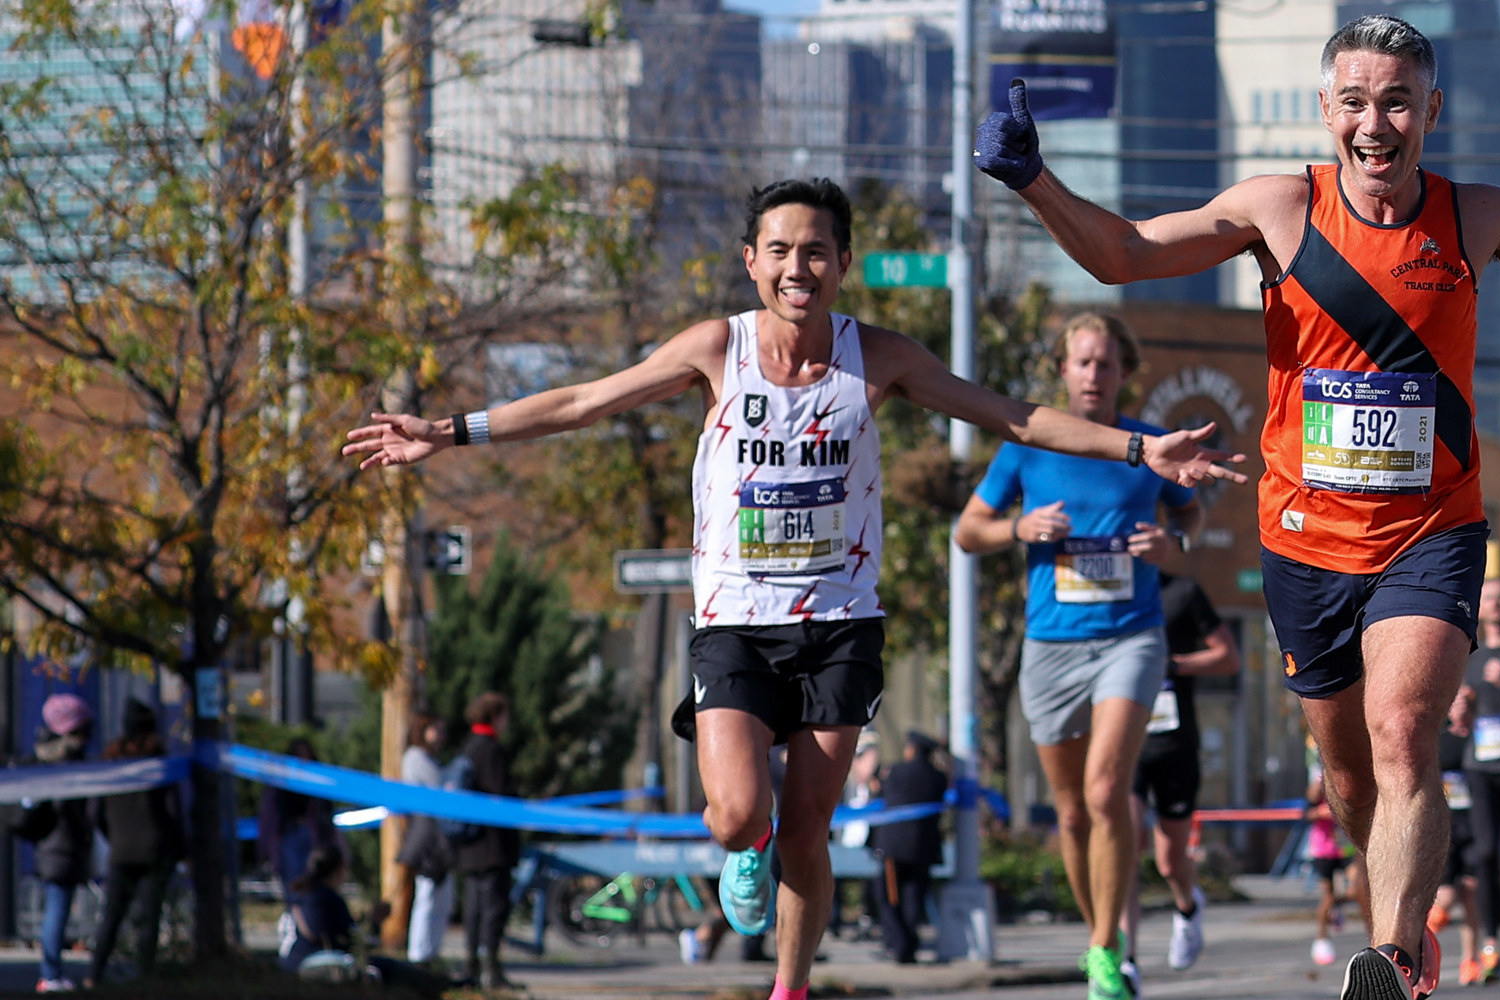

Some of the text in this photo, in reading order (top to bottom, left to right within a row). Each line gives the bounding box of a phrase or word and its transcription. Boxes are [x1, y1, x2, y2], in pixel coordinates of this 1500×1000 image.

[1001, 12, 1108, 33] RUNNING
[1390, 259, 1468, 281] CENTRAL PARK
[1404, 281, 1434, 291] TRACK
[1321, 376, 1353, 399] tcs
[1319, 426, 1328, 445] A
[1352, 409, 1397, 448] 592
[1419, 416, 1428, 442] 2021
[737, 439, 850, 467] FOR KIM
[753, 486, 780, 505] tcs
[784, 510, 814, 540] 614
